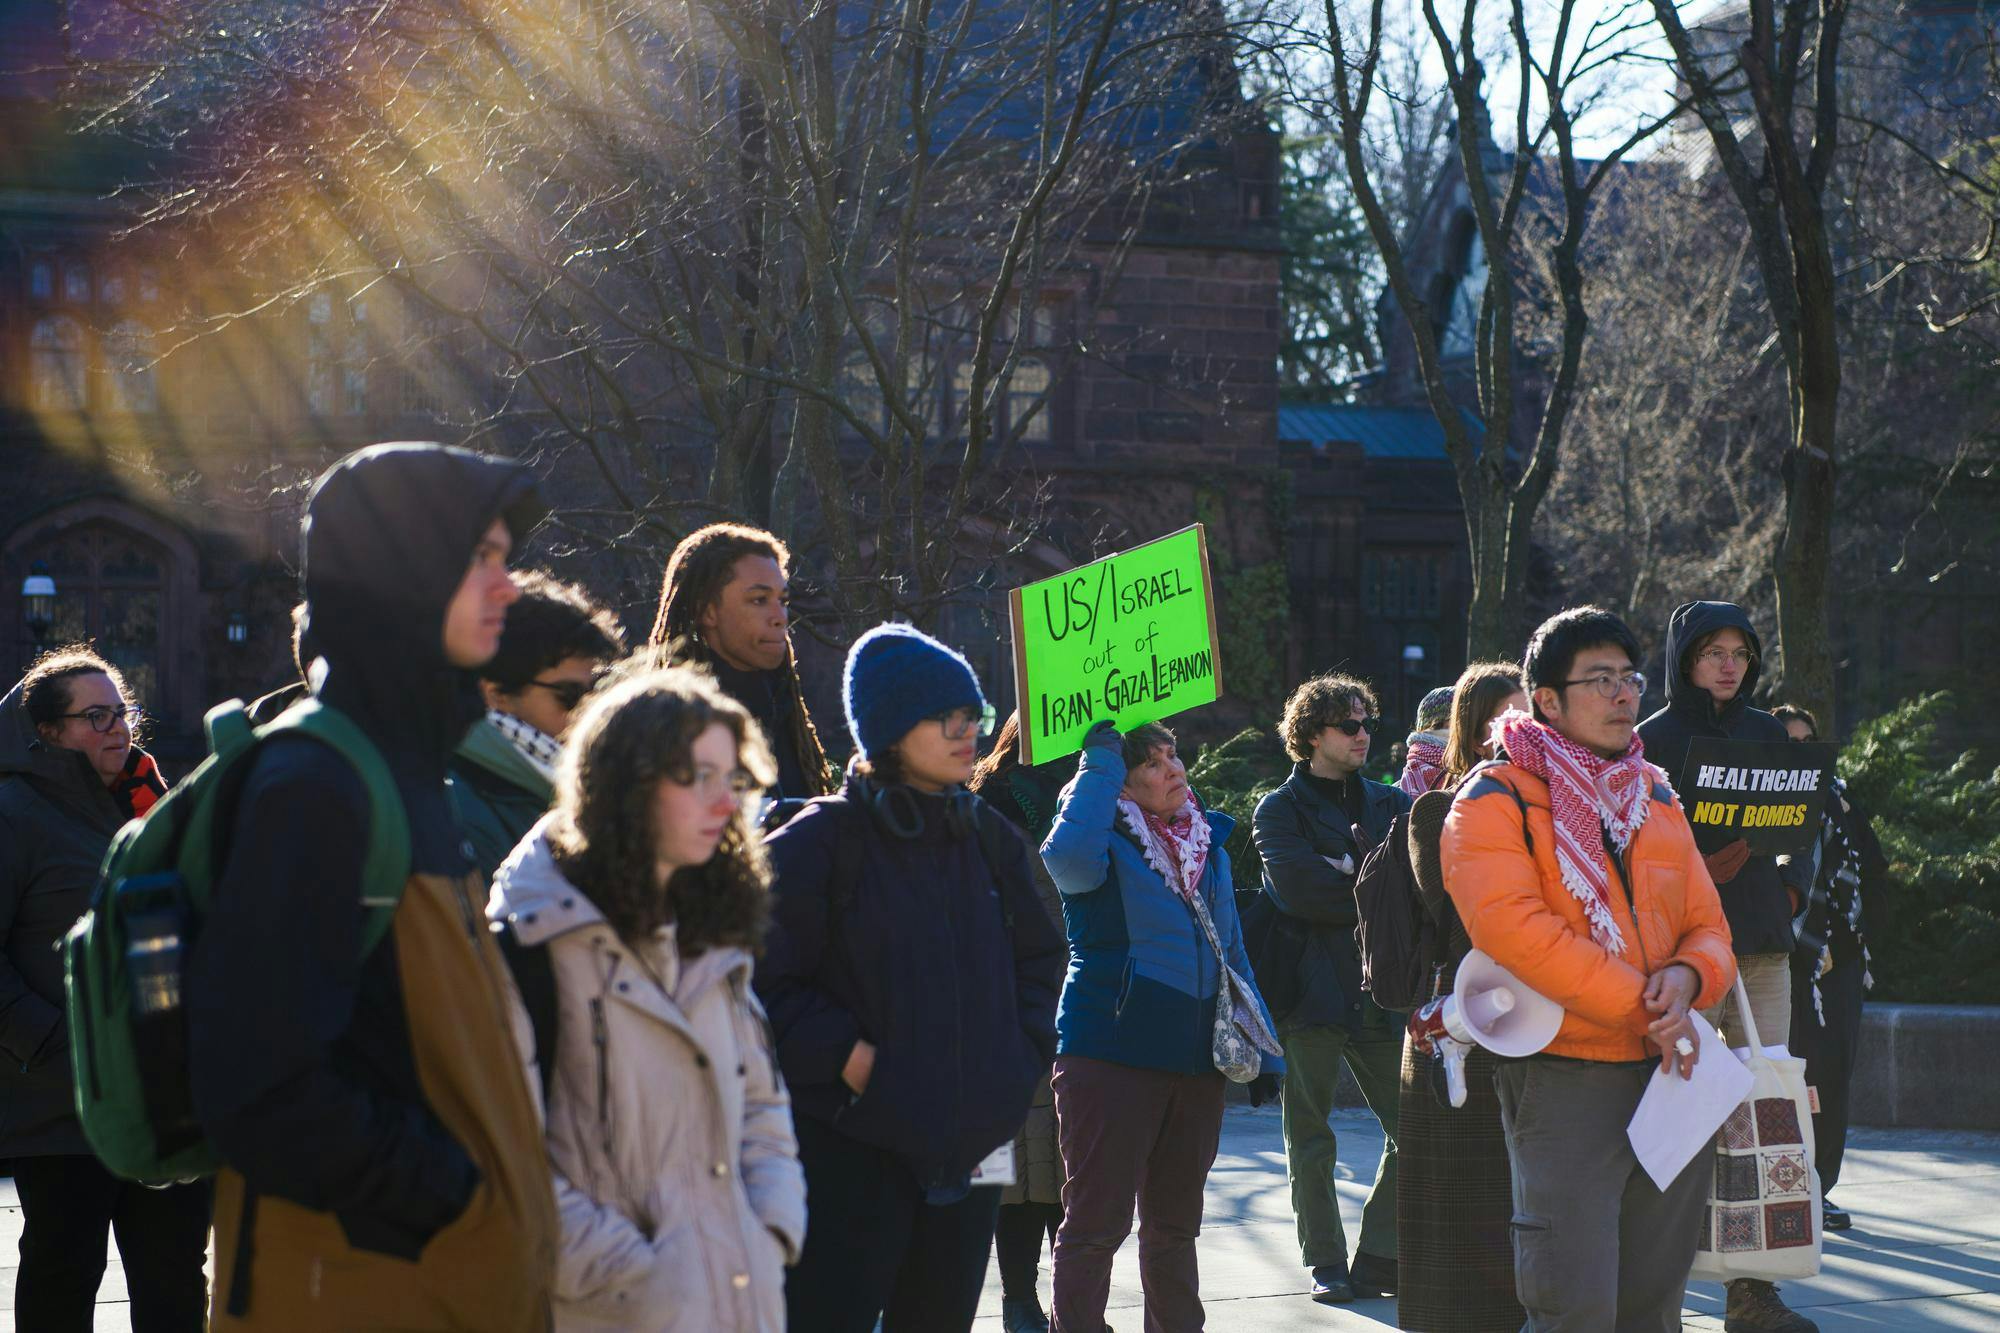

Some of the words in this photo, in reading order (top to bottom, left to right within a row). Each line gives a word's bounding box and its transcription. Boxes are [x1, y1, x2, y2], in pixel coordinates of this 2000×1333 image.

[1044, 562, 1192, 645] US/ISRAEL
[1083, 640, 1117, 674] out
[1135, 621, 1159, 653] of
[1696, 765, 1821, 792] HEALTHCARE
[1693, 801, 1739, 826] NOT
[1742, 803, 1807, 828] BOMBS
